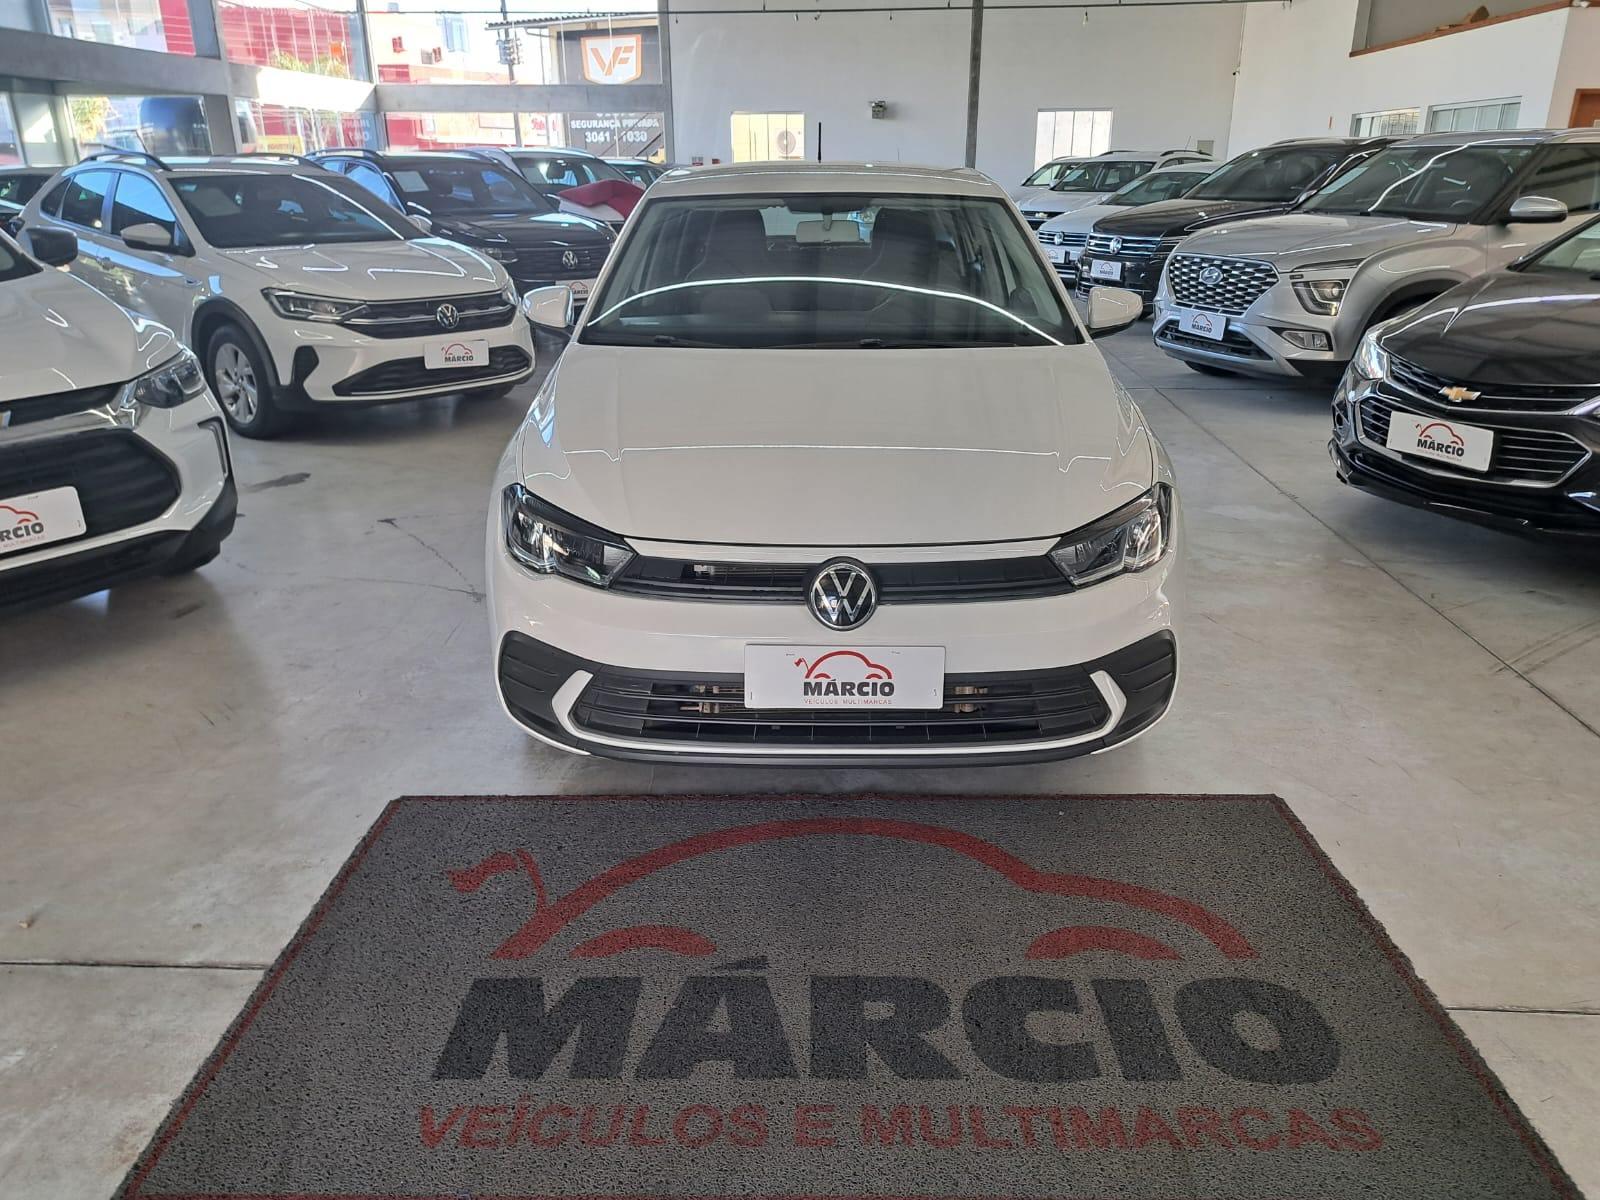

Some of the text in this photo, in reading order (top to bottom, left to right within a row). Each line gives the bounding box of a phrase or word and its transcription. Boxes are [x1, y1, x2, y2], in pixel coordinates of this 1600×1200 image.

[570, 119, 621, 130] SEGURANÇA
[585, 131, 611, 143] 3041
[621, 131, 648, 143] 1030
[1416, 438, 1465, 458] MÁRCIO
[803, 678, 895, 697] MÁRCIO
[430, 956, 1342, 1084] MÁRCIO
[794, 1104, 837, 1149] E
[858, 1102, 1385, 1152] MULTIMARCAS
